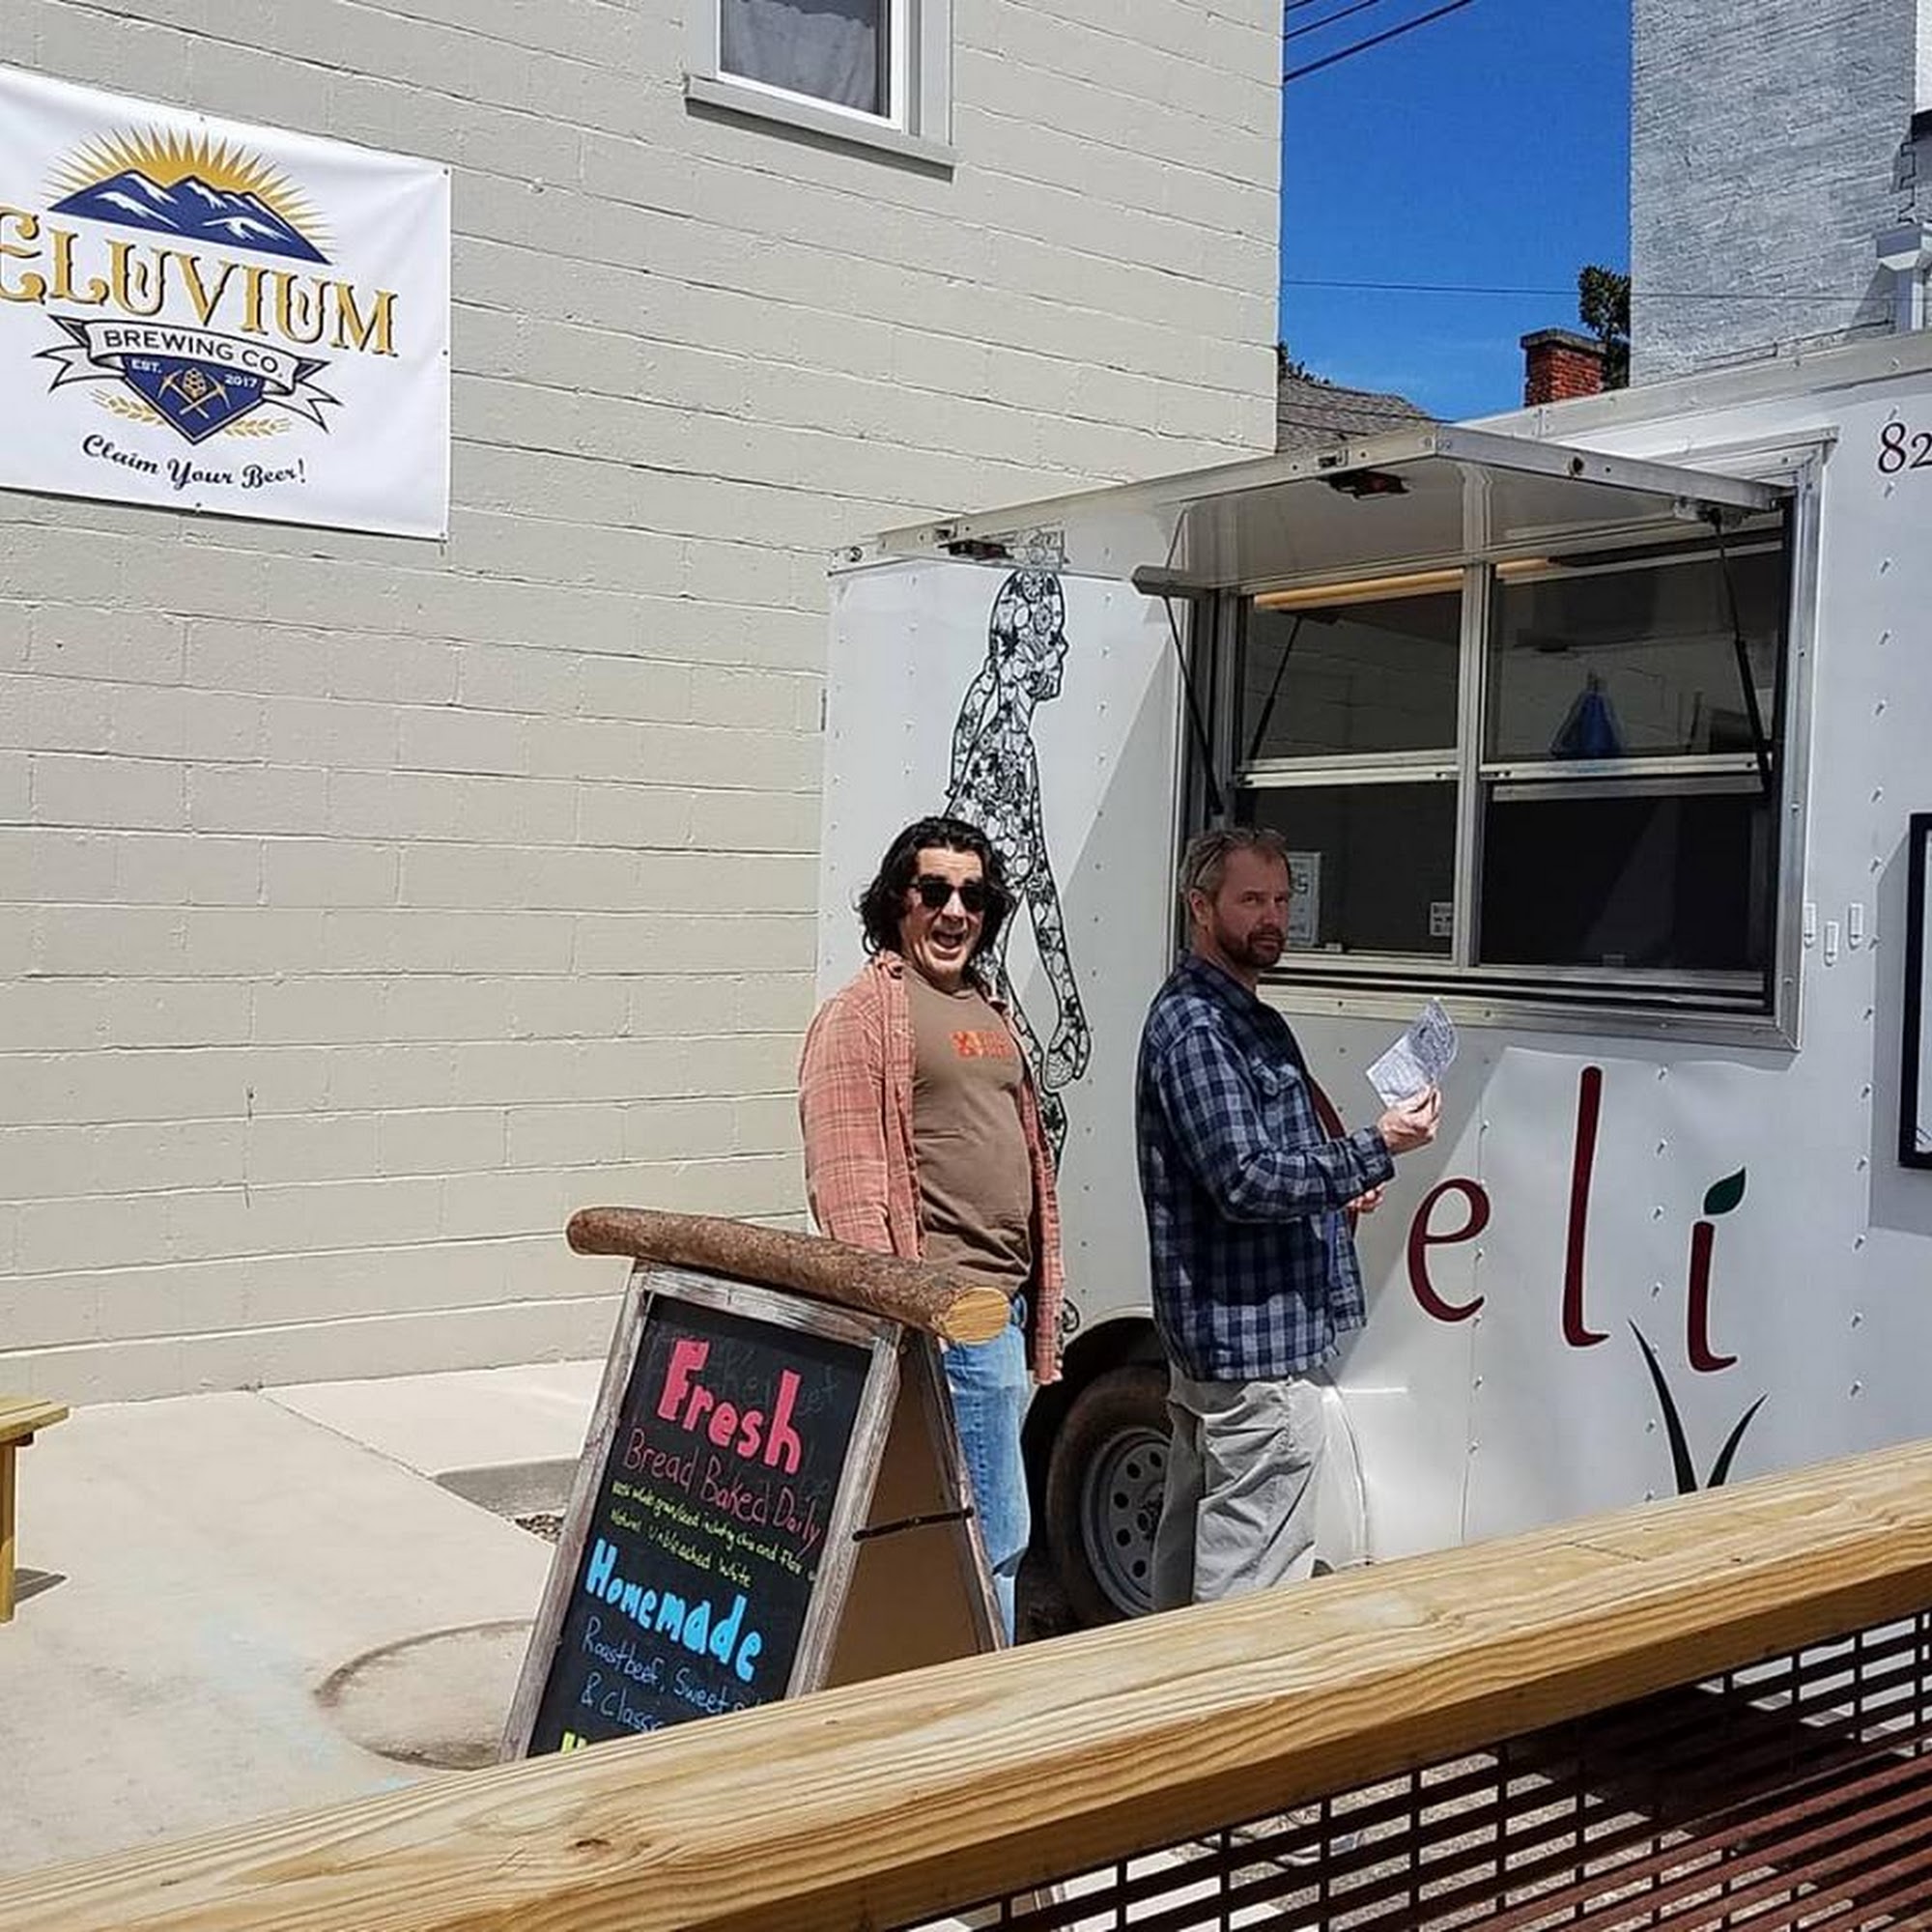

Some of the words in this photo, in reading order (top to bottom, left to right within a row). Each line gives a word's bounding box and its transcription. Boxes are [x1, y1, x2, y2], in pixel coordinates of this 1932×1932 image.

[0, 206, 399, 357] ELUVIUM
[103, 329, 234, 360] BREWING
[242, 350, 284, 378] CO.
[130, 358, 162, 374] EST.
[224, 374, 258, 388] 2017
[83, 434, 158, 475] Claim
[167, 457, 235, 491] Your
[242, 458, 306, 489] Beer!
[1307, 1065, 1745, 1373] eli
[658, 1340, 801, 1475] Fresh
[623, 1429, 698, 1493] Bread
[700, 1455, 771, 1526] Baked
[774, 1487, 821, 1559] Daily
[585, 1539, 763, 1682] Homemade
[582, 1672, 602, 1707] &
[673, 1666, 729, 1714] Sweet
